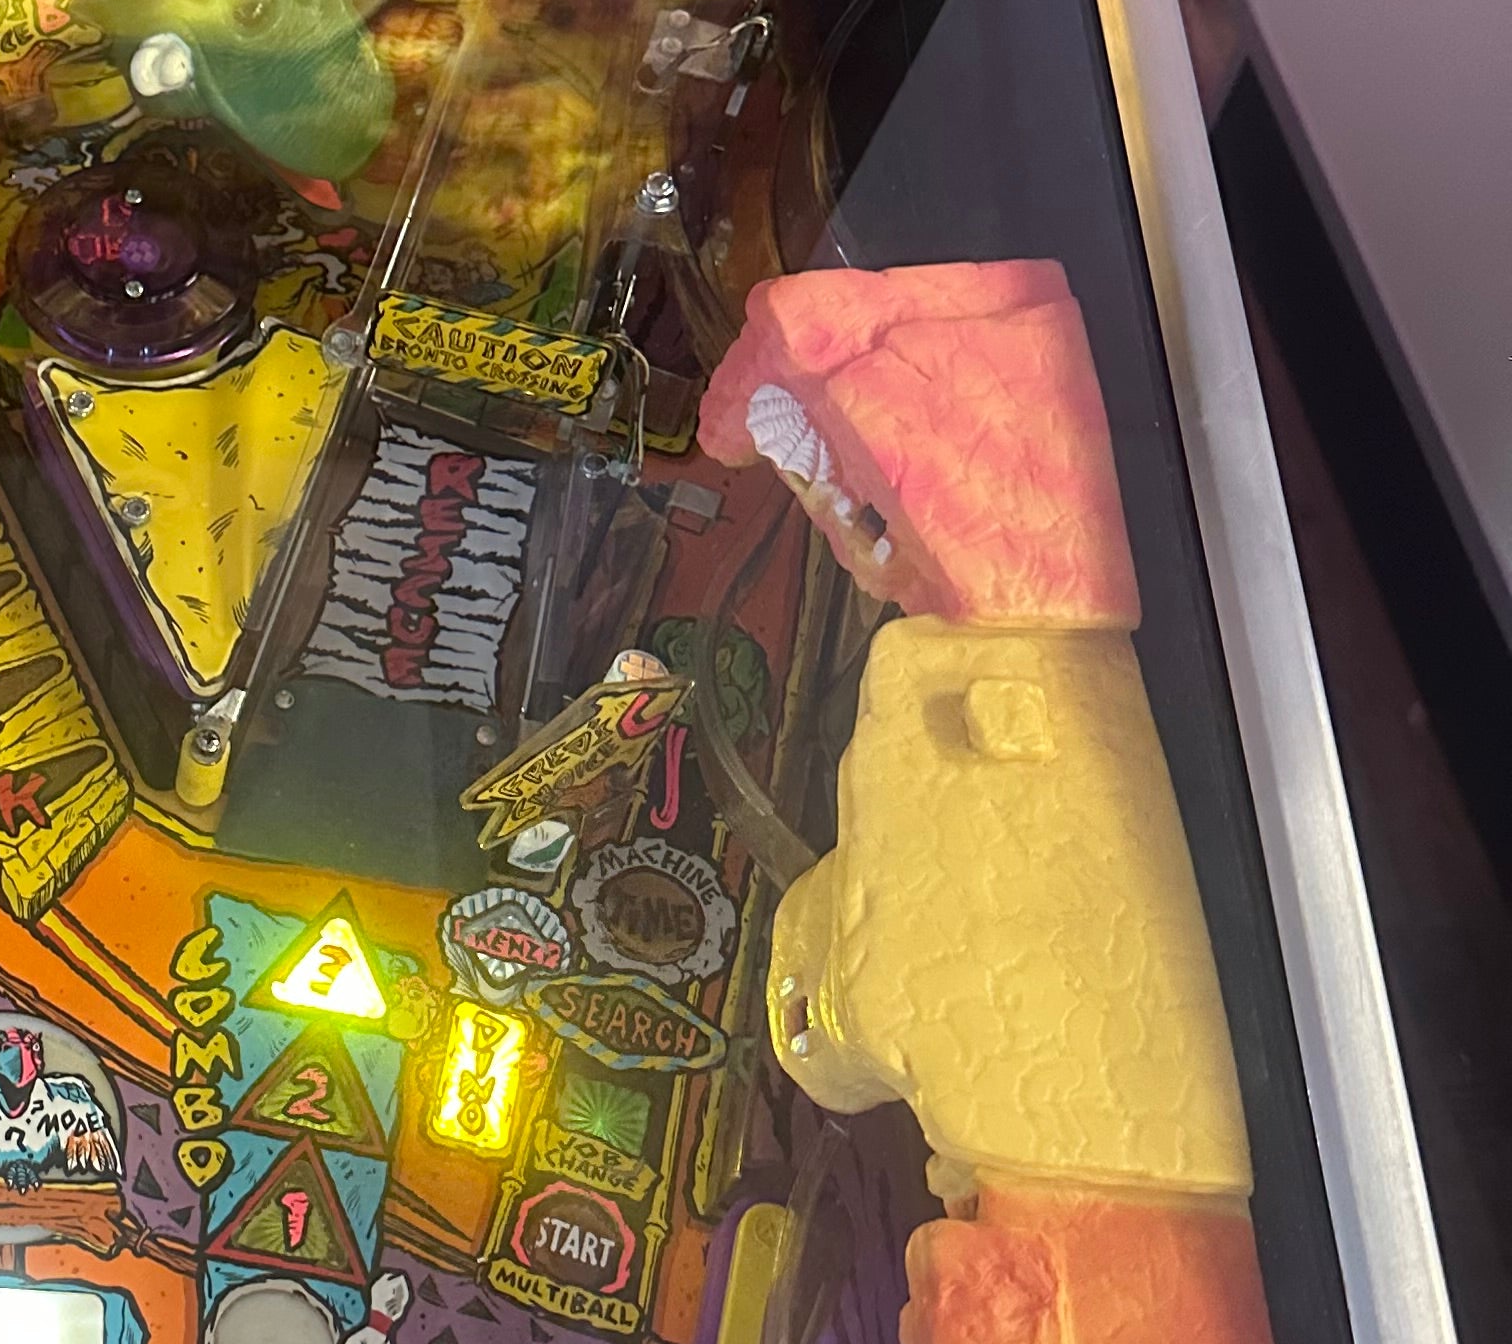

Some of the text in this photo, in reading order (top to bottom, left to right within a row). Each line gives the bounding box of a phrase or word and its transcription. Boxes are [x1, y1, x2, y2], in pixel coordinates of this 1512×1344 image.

[391, 315, 584, 381] CAUTION
[597, 844, 722, 907] MACHINE
[308, 943, 353, 998] 3
[559, 985, 698, 1058] SEARCH
[282, 1061, 337, 1124] 2
[456, 1011, 509, 1136] DINO
[36, 1110, 102, 1137] MODE
[558, 1137, 623, 1170] JOB
[544, 1147, 638, 1194] CHANGE
[278, 1187, 311, 1251] 1
[534, 1217, 616, 1269] START
[495, 1268, 635, 1328] MULTIBALL
